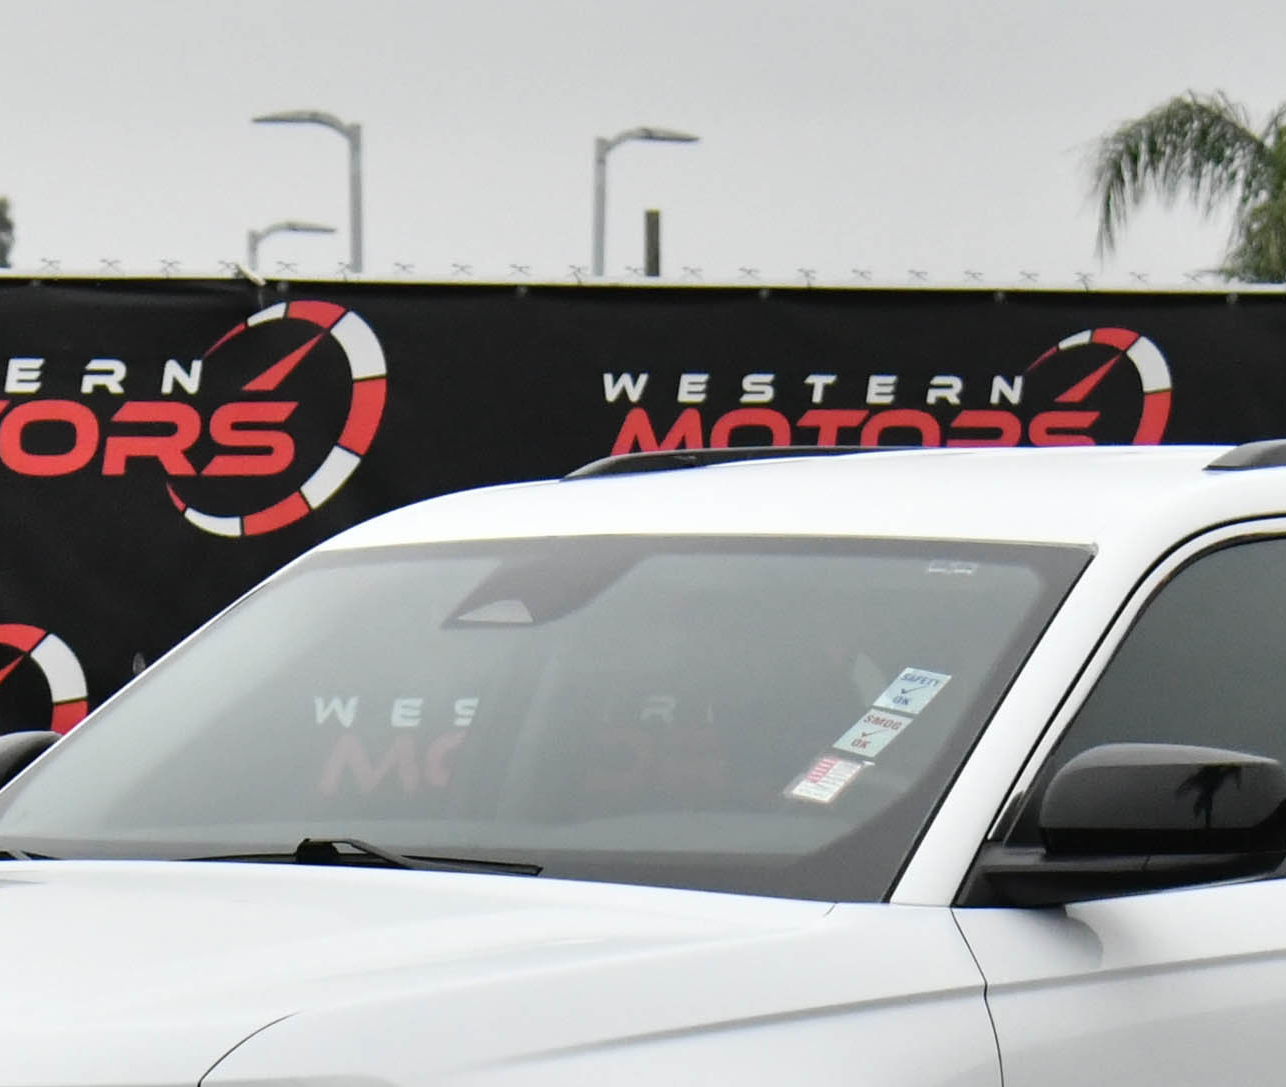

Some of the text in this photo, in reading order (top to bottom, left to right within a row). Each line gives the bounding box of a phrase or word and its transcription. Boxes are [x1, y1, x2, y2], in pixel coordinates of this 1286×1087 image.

[603, 372, 1024, 404] WESTERN
[900, 672, 941, 688] SAFETY
[892, 695, 910, 706] OK
[863, 714, 903, 731] SMOG
[850, 738, 871, 750] OK
